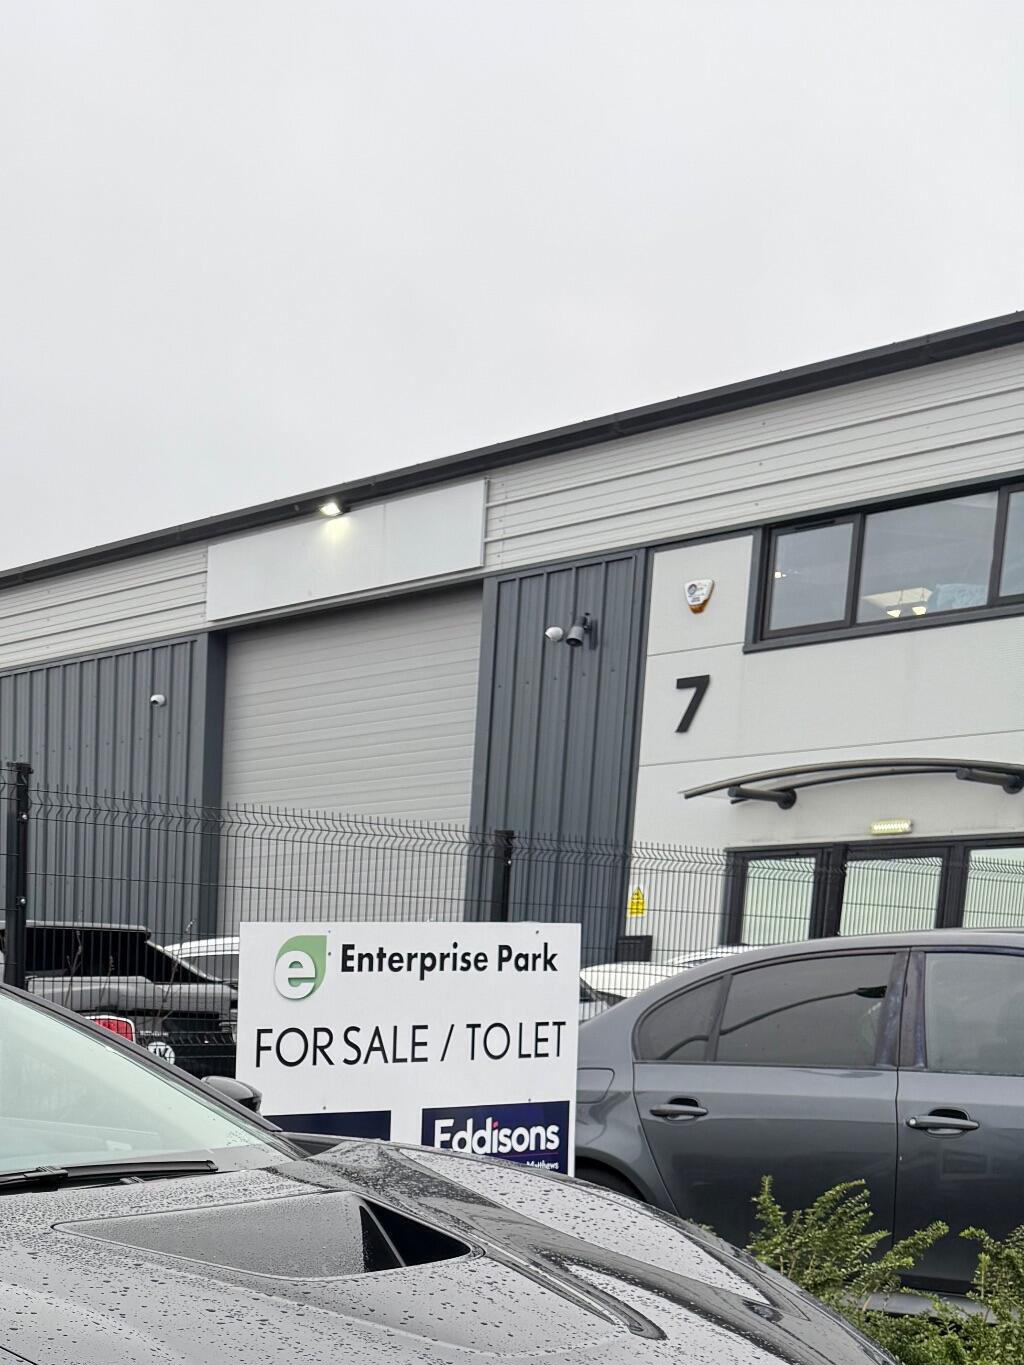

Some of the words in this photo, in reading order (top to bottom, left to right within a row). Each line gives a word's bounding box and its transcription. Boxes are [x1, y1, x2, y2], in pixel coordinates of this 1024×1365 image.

[674, 674, 711, 733] 7
[340, 941, 489, 981] Enterprise
[497, 942, 558, 972] Park
[255, 1027, 334, 1068] FOR
[343, 1024, 429, 1065] SALE
[433, 1116, 560, 1155] Eddisons
[526, 1160, 559, 1170] Mtthews
